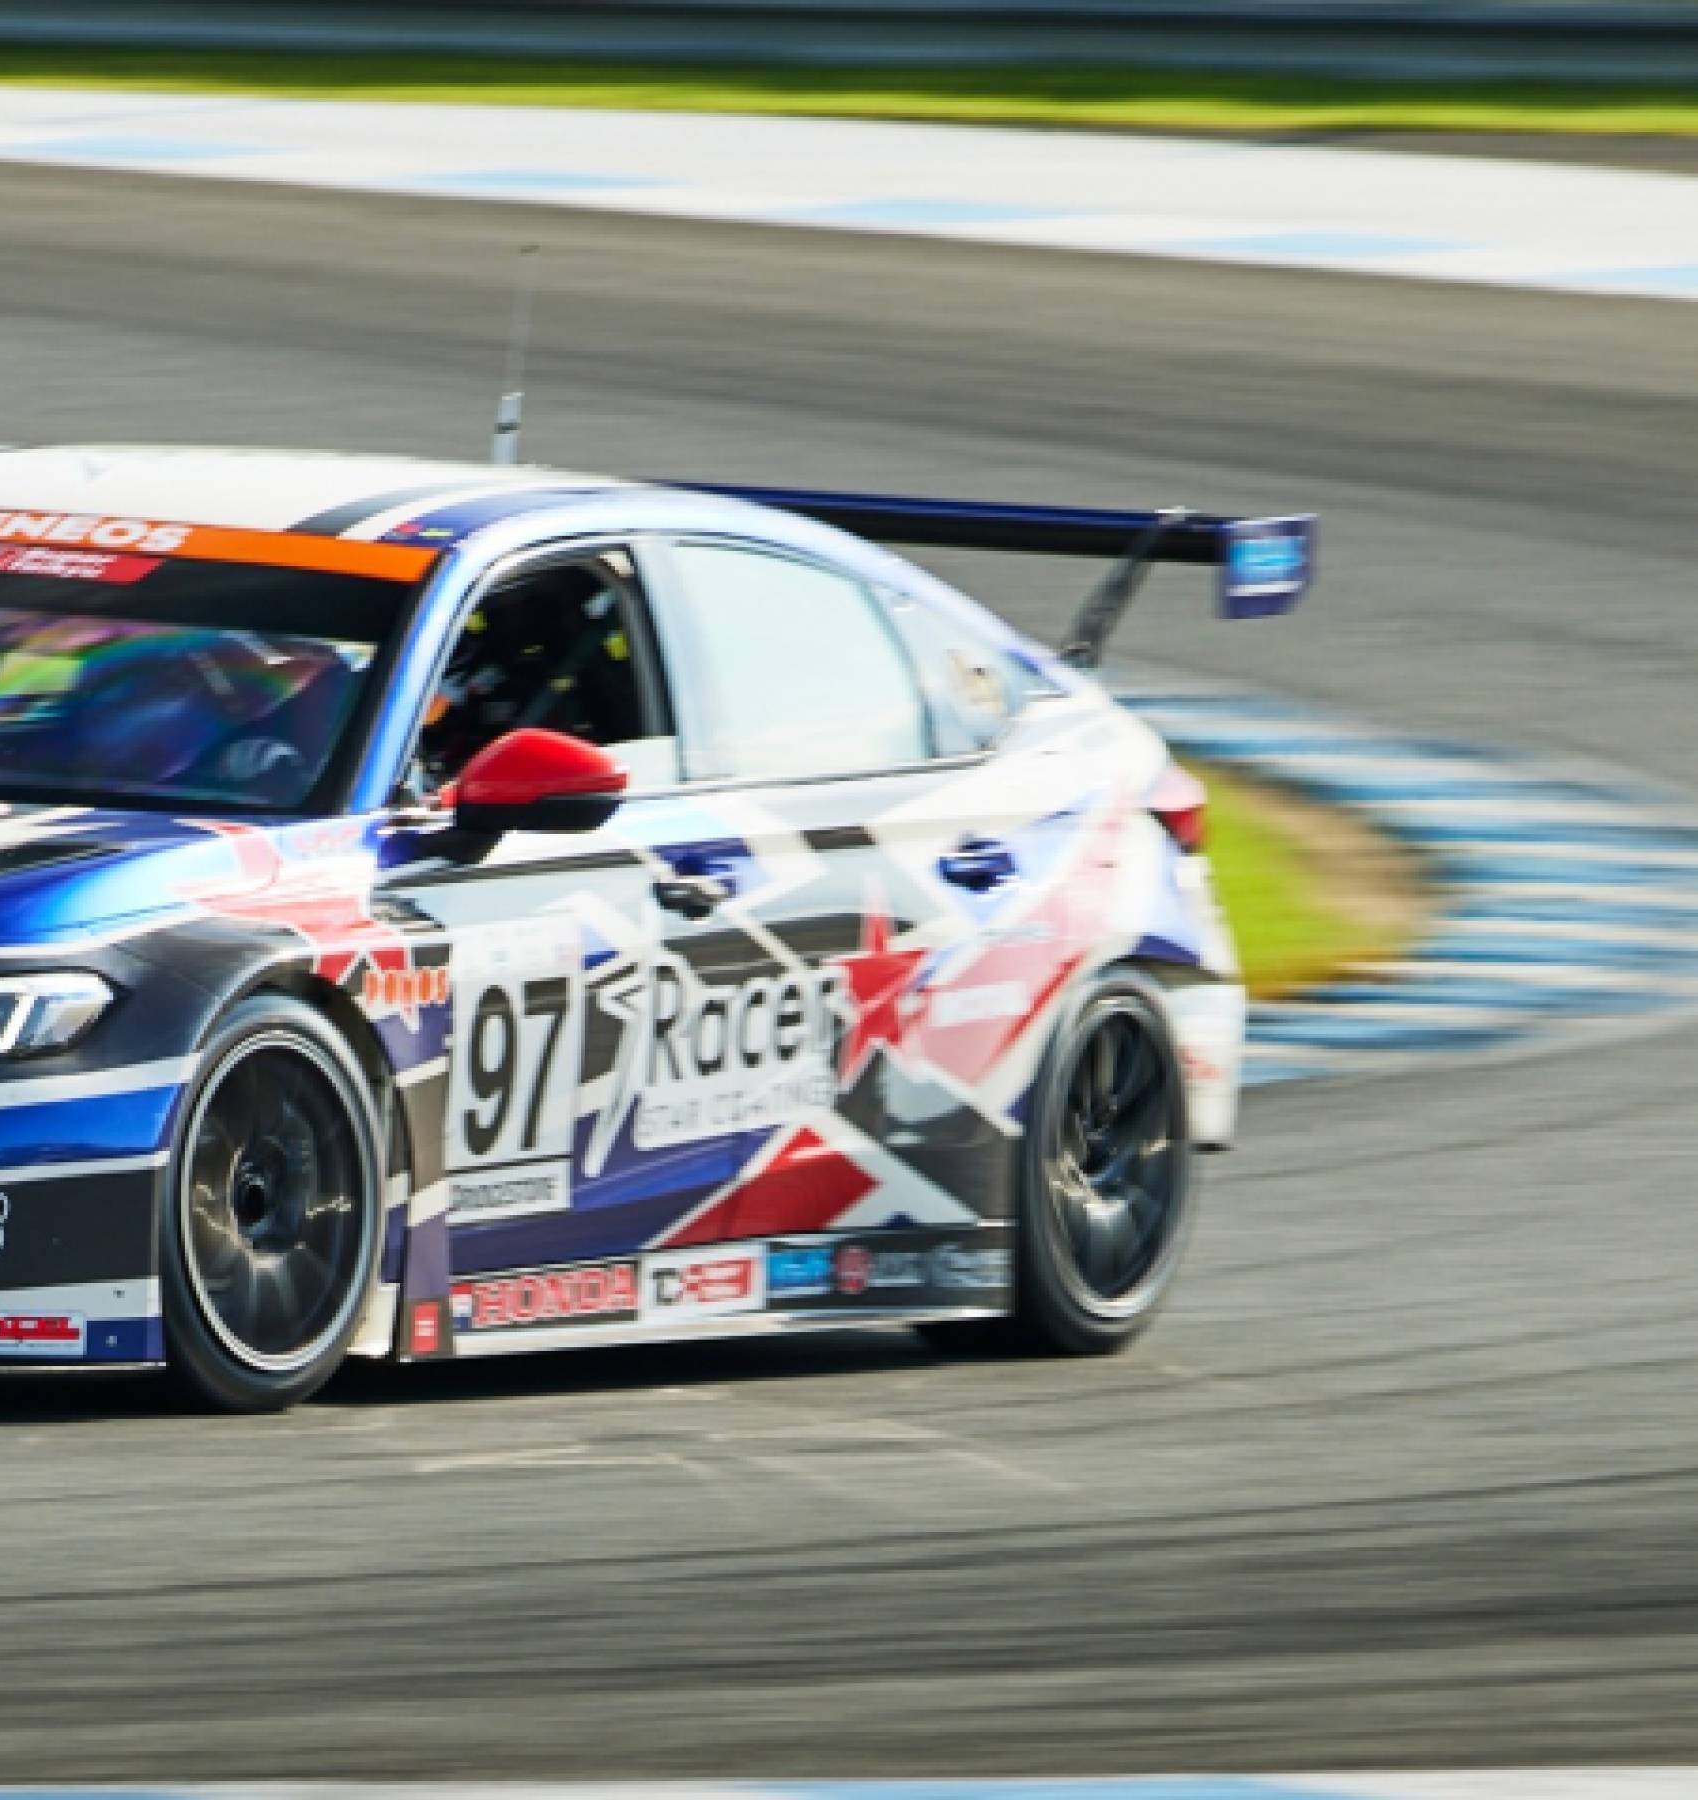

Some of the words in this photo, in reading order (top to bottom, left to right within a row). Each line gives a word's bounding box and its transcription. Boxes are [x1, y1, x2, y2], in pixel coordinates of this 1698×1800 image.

[463, 976, 569, 1156] 97
[644, 962, 843, 1086] Racer
[472, 1264, 638, 1328] HONDA
